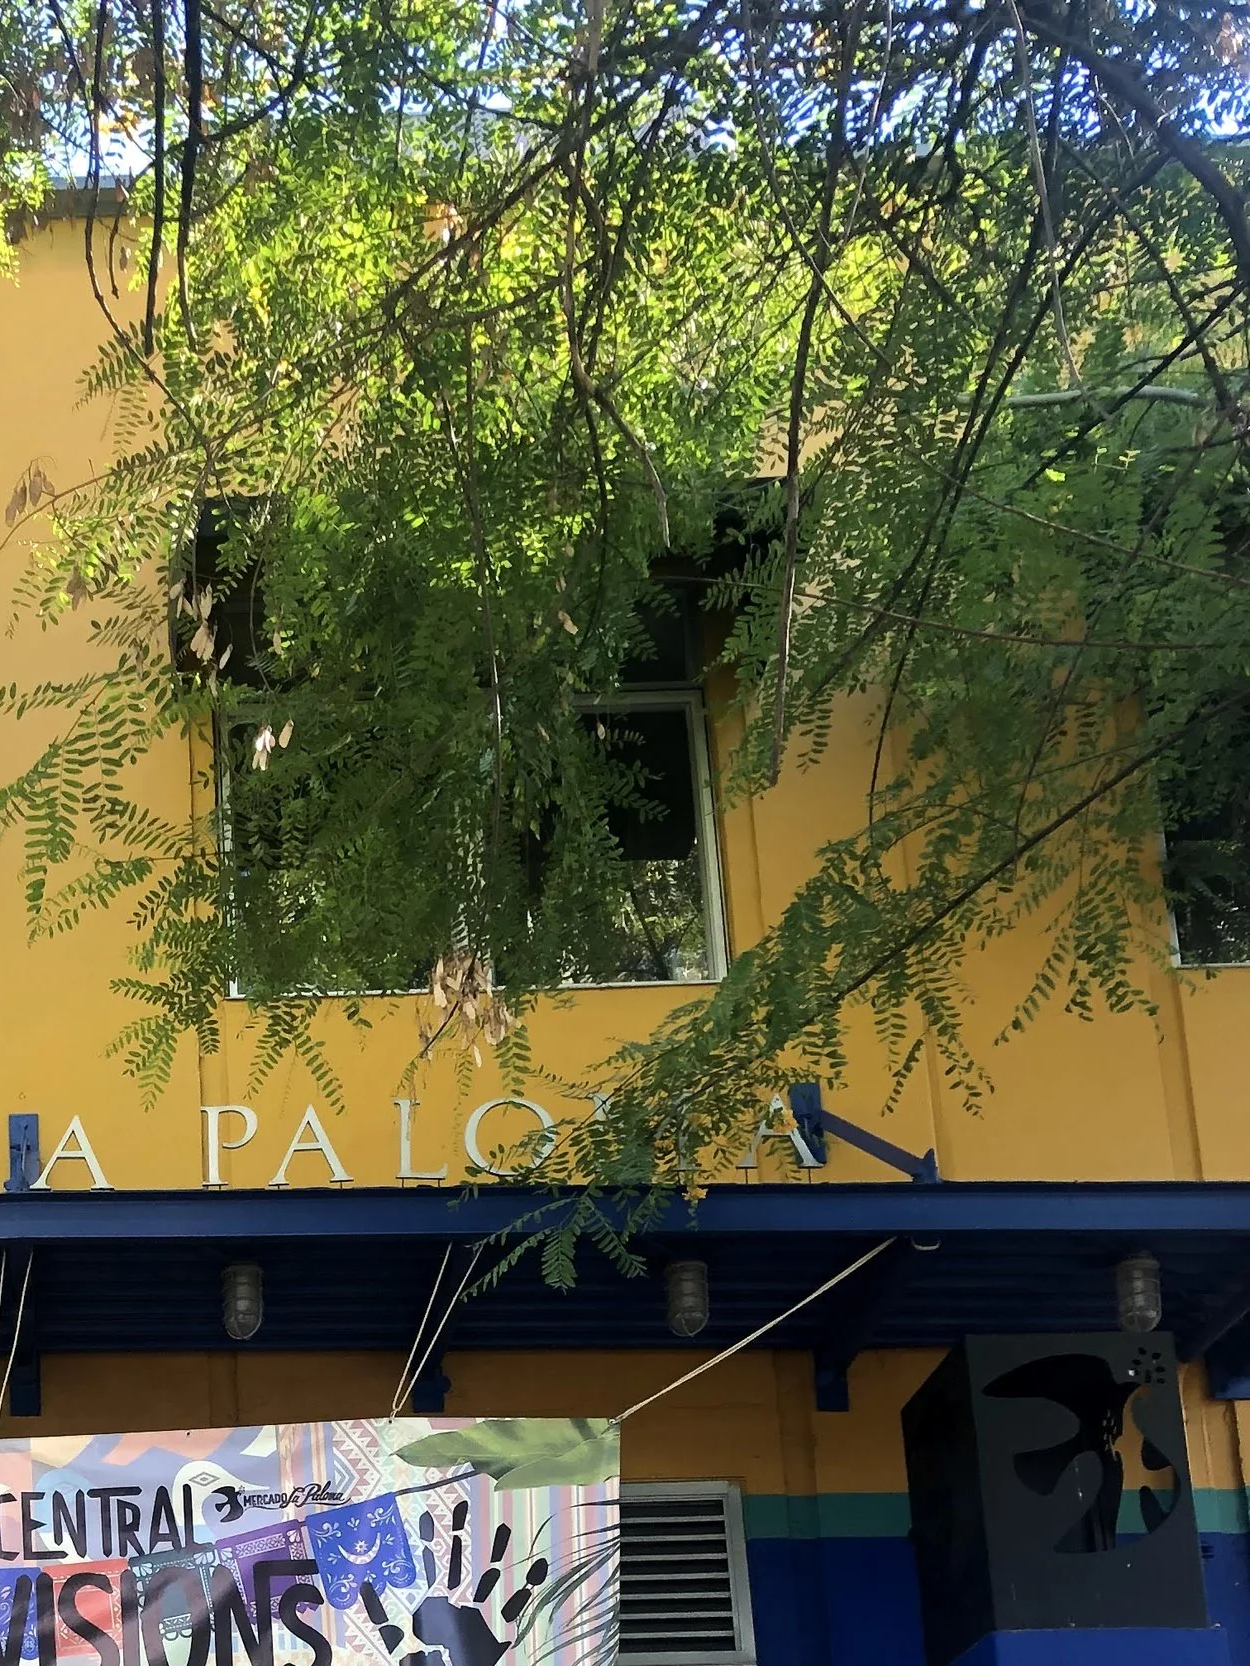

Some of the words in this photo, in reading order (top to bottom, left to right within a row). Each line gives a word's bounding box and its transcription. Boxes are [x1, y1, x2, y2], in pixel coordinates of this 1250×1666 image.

[8, 1114, 115, 1191] A
[201, 1091, 825, 1187] PALOA
[243, 1490, 288, 1508] MERCADO
